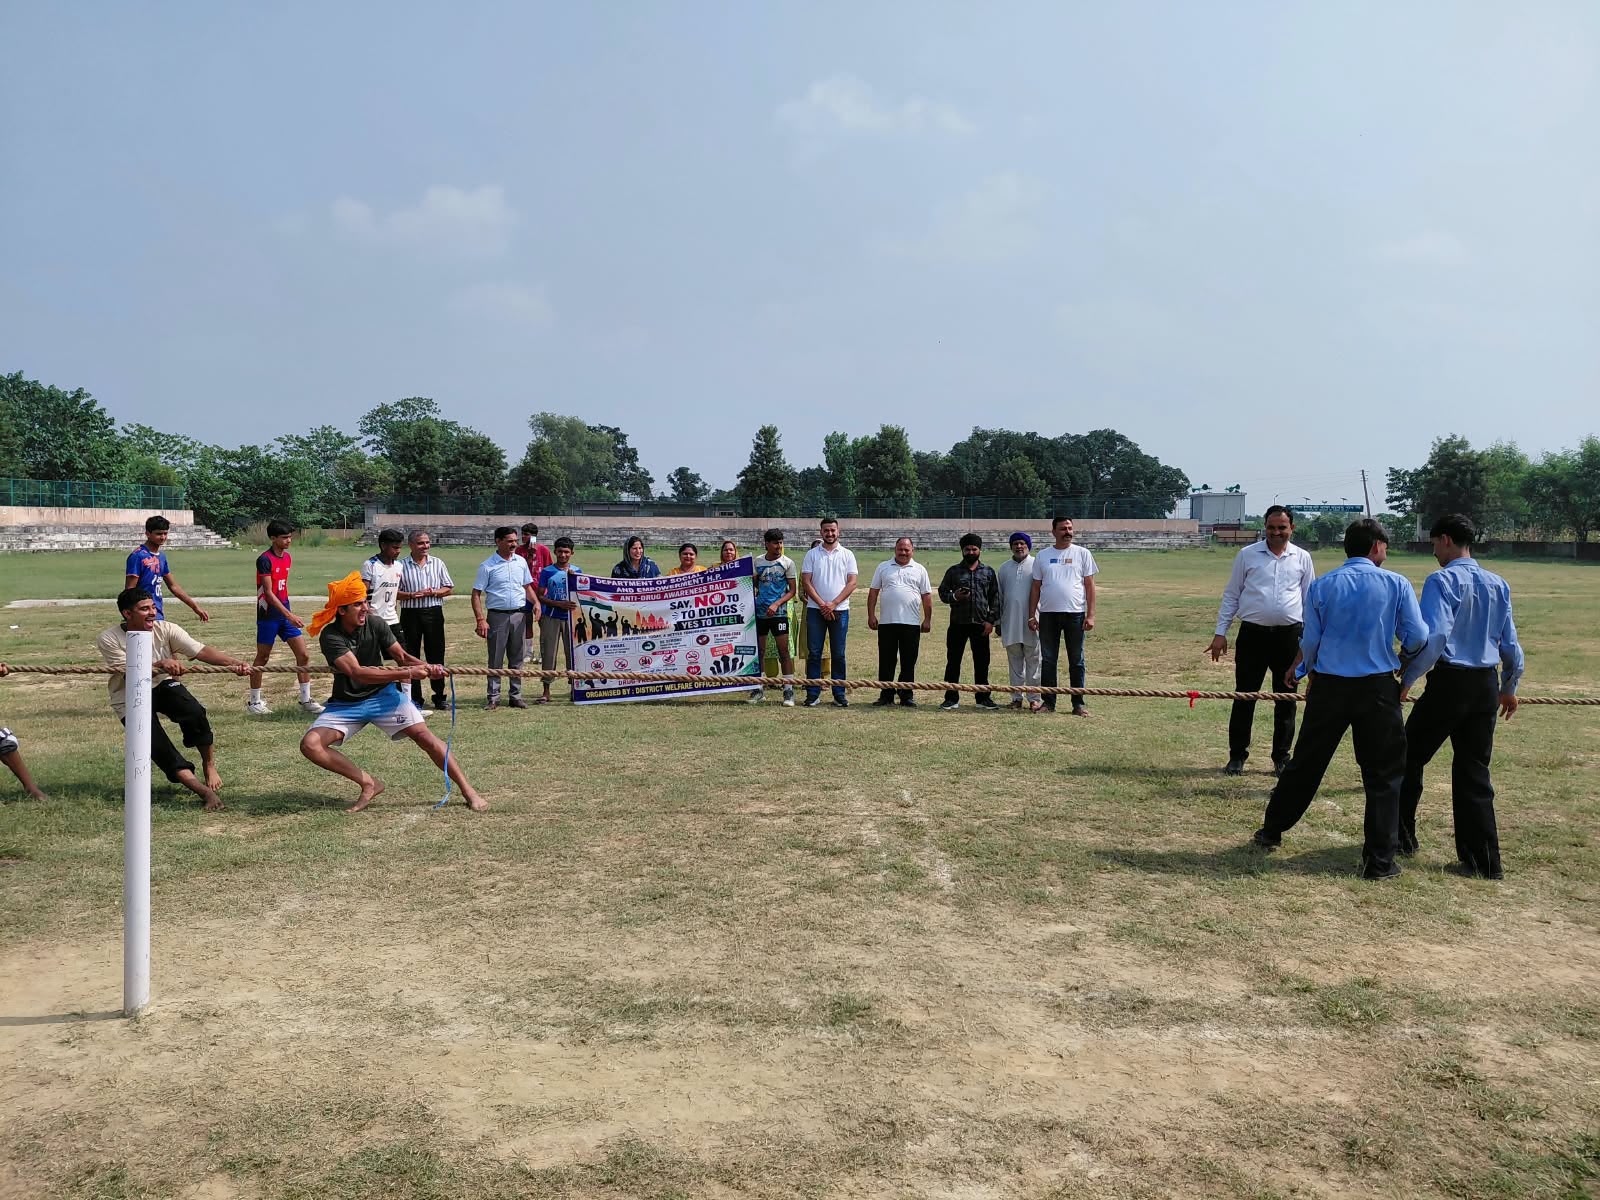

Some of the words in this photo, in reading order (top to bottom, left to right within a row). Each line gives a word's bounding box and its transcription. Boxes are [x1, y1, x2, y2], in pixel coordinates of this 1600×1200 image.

[596, 578, 653, 586] DEPARTMENT
[670, 573, 701, 583] SOCIAL
[704, 561, 740, 575] JUSTICE
[620, 594, 661, 602] ANTI-DRUG
[663, 586, 708, 599] AWARENESS
[709, 581, 731, 593] RALLY
[637, 577, 704, 592] EMPOWERMENT
[670, 600, 692, 610] SAY,
[694, 592, 726, 608] NO
[726, 594, 740, 603] TO
[681, 610, 696, 619] TO
[699, 604, 738, 618] DRUGS
[681, 621, 699, 629] YES
[714, 616, 738, 625] LIFE!
[585, 689, 621, 698] ORGANISED
[635, 684, 663, 694] DISTRICT
[664, 682, 693, 691] WELFARE
[694, 681, 721, 689] OFFICER
